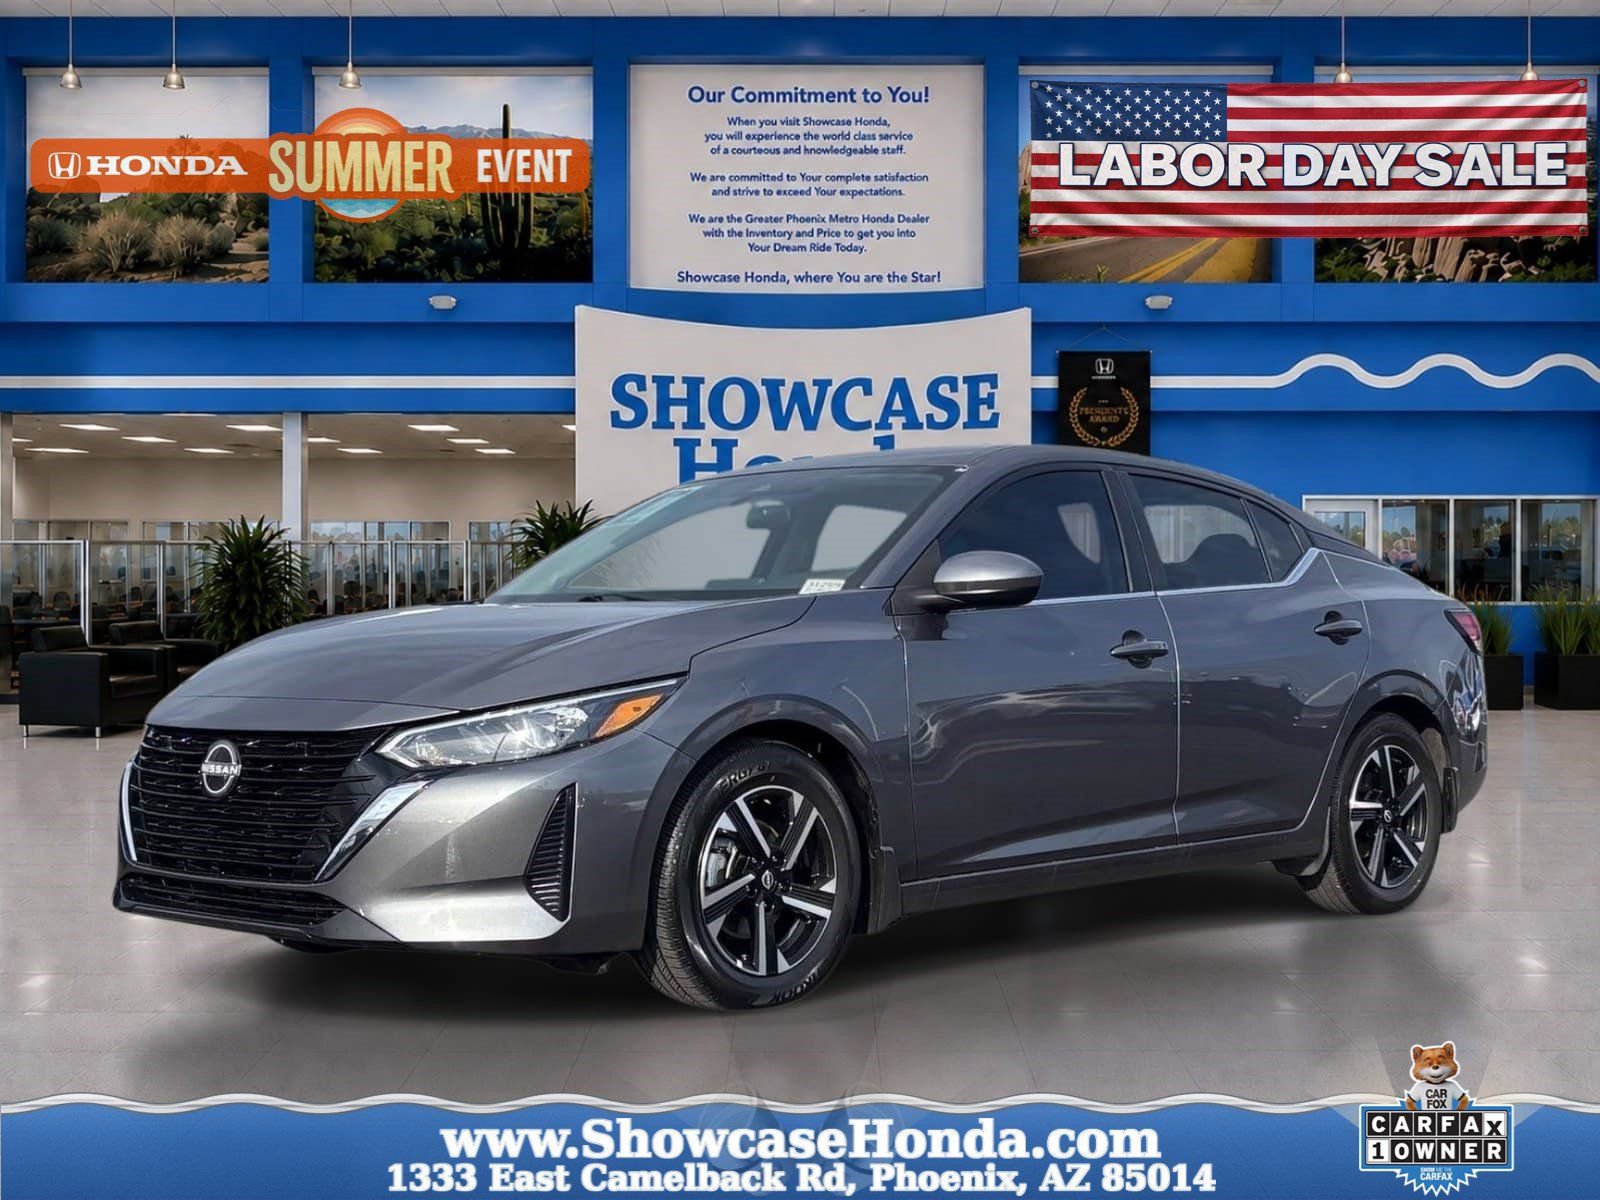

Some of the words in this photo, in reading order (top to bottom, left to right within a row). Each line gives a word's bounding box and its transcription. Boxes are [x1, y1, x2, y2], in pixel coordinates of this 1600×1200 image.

[687, 85, 726, 104] Our
[730, 85, 857, 104] Commitment
[861, 87, 883, 104] to
[886, 85, 930, 104] You!
[726, 116, 757, 127] When
[758, 118, 778, 129] you
[779, 116, 801, 127] visit
[802, 116, 853, 127] Showcase
[854, 116, 891, 129] Honda,
[704, 133, 724, 144] you
[725, 130, 743, 141] will
[744, 130, 801, 144] experience
[802, 130, 820, 141] the
[821, 130, 851, 141] world
[852, 130, 877, 141] class
[878, 130, 914, 142] service
[709, 144, 721, 155] of
[722, 147, 730, 155] a
[730, 146, 782, 156] courteous
[782, 144, 802, 156] and
[881, 144, 906, 155] staff.
[86, 155, 248, 176] HONDA
[268, 139, 454, 193] SUMMER
[477, 148, 572, 183] EVENT
[1058, 142, 1268, 187] LABOR
[1282, 142, 1405, 188] DAY
[1414, 141, 1568, 188] SALE
[689, 172, 708, 183] We
[709, 174, 727, 182] are
[728, 172, 784, 183] committed
[785, 173, 798, 183] to
[799, 172, 823, 183] Your
[824, 172, 872, 185] complete
[873, 171, 929, 183] satisfaction
[711, 186, 731, 197] and
[732, 186, 761, 197] strive
[762, 187, 774, 197] to
[775, 186, 812, 197] exceed
[814, 186, 838, 197] Your
[839, 186, 906, 200] expectations.
[688, 213, 706, 224] We
[707, 215, 725, 224] are
[725, 213, 743, 224] the
[744, 213, 784, 224] Greater
[785, 213, 827, 224] Phoenix
[828, 213, 860, 224] Metro
[861, 213, 896, 224] Honda
[897, 213, 930, 224] Dealer
[702, 227, 725, 238] with
[726, 227, 744, 238] the
[745, 227, 794, 241] Inventory
[794, 227, 815, 239] and
[816, 227, 842, 239] Price
[843, 229, 855, 238] to
[856, 229, 875, 241] get
[876, 230, 895, 241] you
[747, 242, 771, 253] Your
[772, 242, 808, 253] Dream
[809, 242, 833, 253] Ride
[834, 242, 867, 255] Today.
[676, 270, 741, 284] Showcase
[744, 270, 790, 286] Honda,
[793, 270, 834, 284] where
[836, 271, 861, 284] You
[863, 274, 884, 284] are
[886, 271, 908, 284] the
[911, 271, 941, 284] Star!
[610, 372, 1001, 432] SHOWCASE
